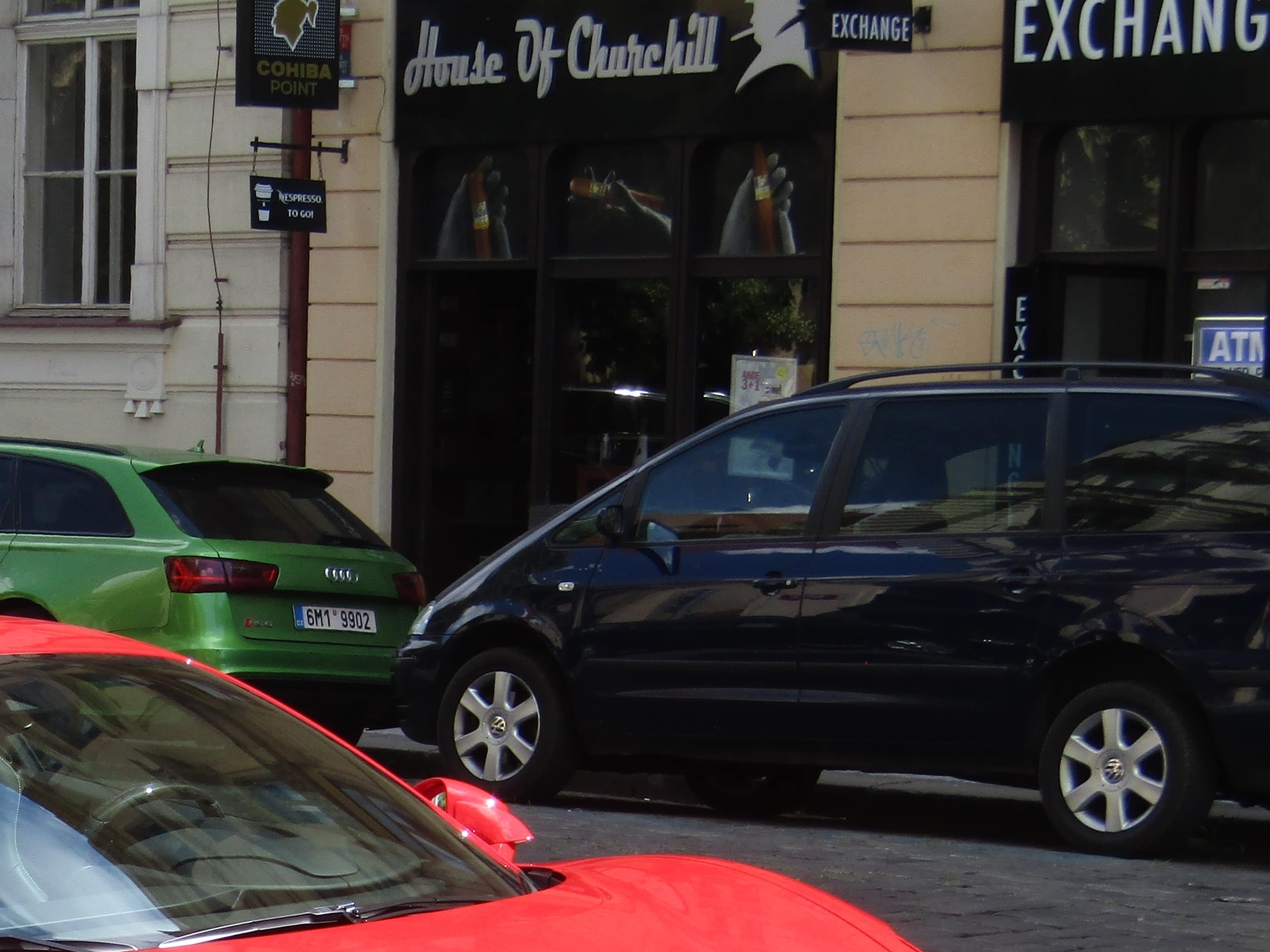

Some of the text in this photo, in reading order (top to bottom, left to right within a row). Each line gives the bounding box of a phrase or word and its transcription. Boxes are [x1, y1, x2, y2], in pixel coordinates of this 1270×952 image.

[831, 12, 910, 42] EXCHANGE
[403, 12, 719, 99] House Of Churchill
[256, 60, 332, 80] COHIBA
[270, 80, 317, 97] POINT
[276, 189, 322, 204] NESPRESSO
[287, 209, 314, 218] TO GO!
[306, 608, 371, 630] 6M1 9902
